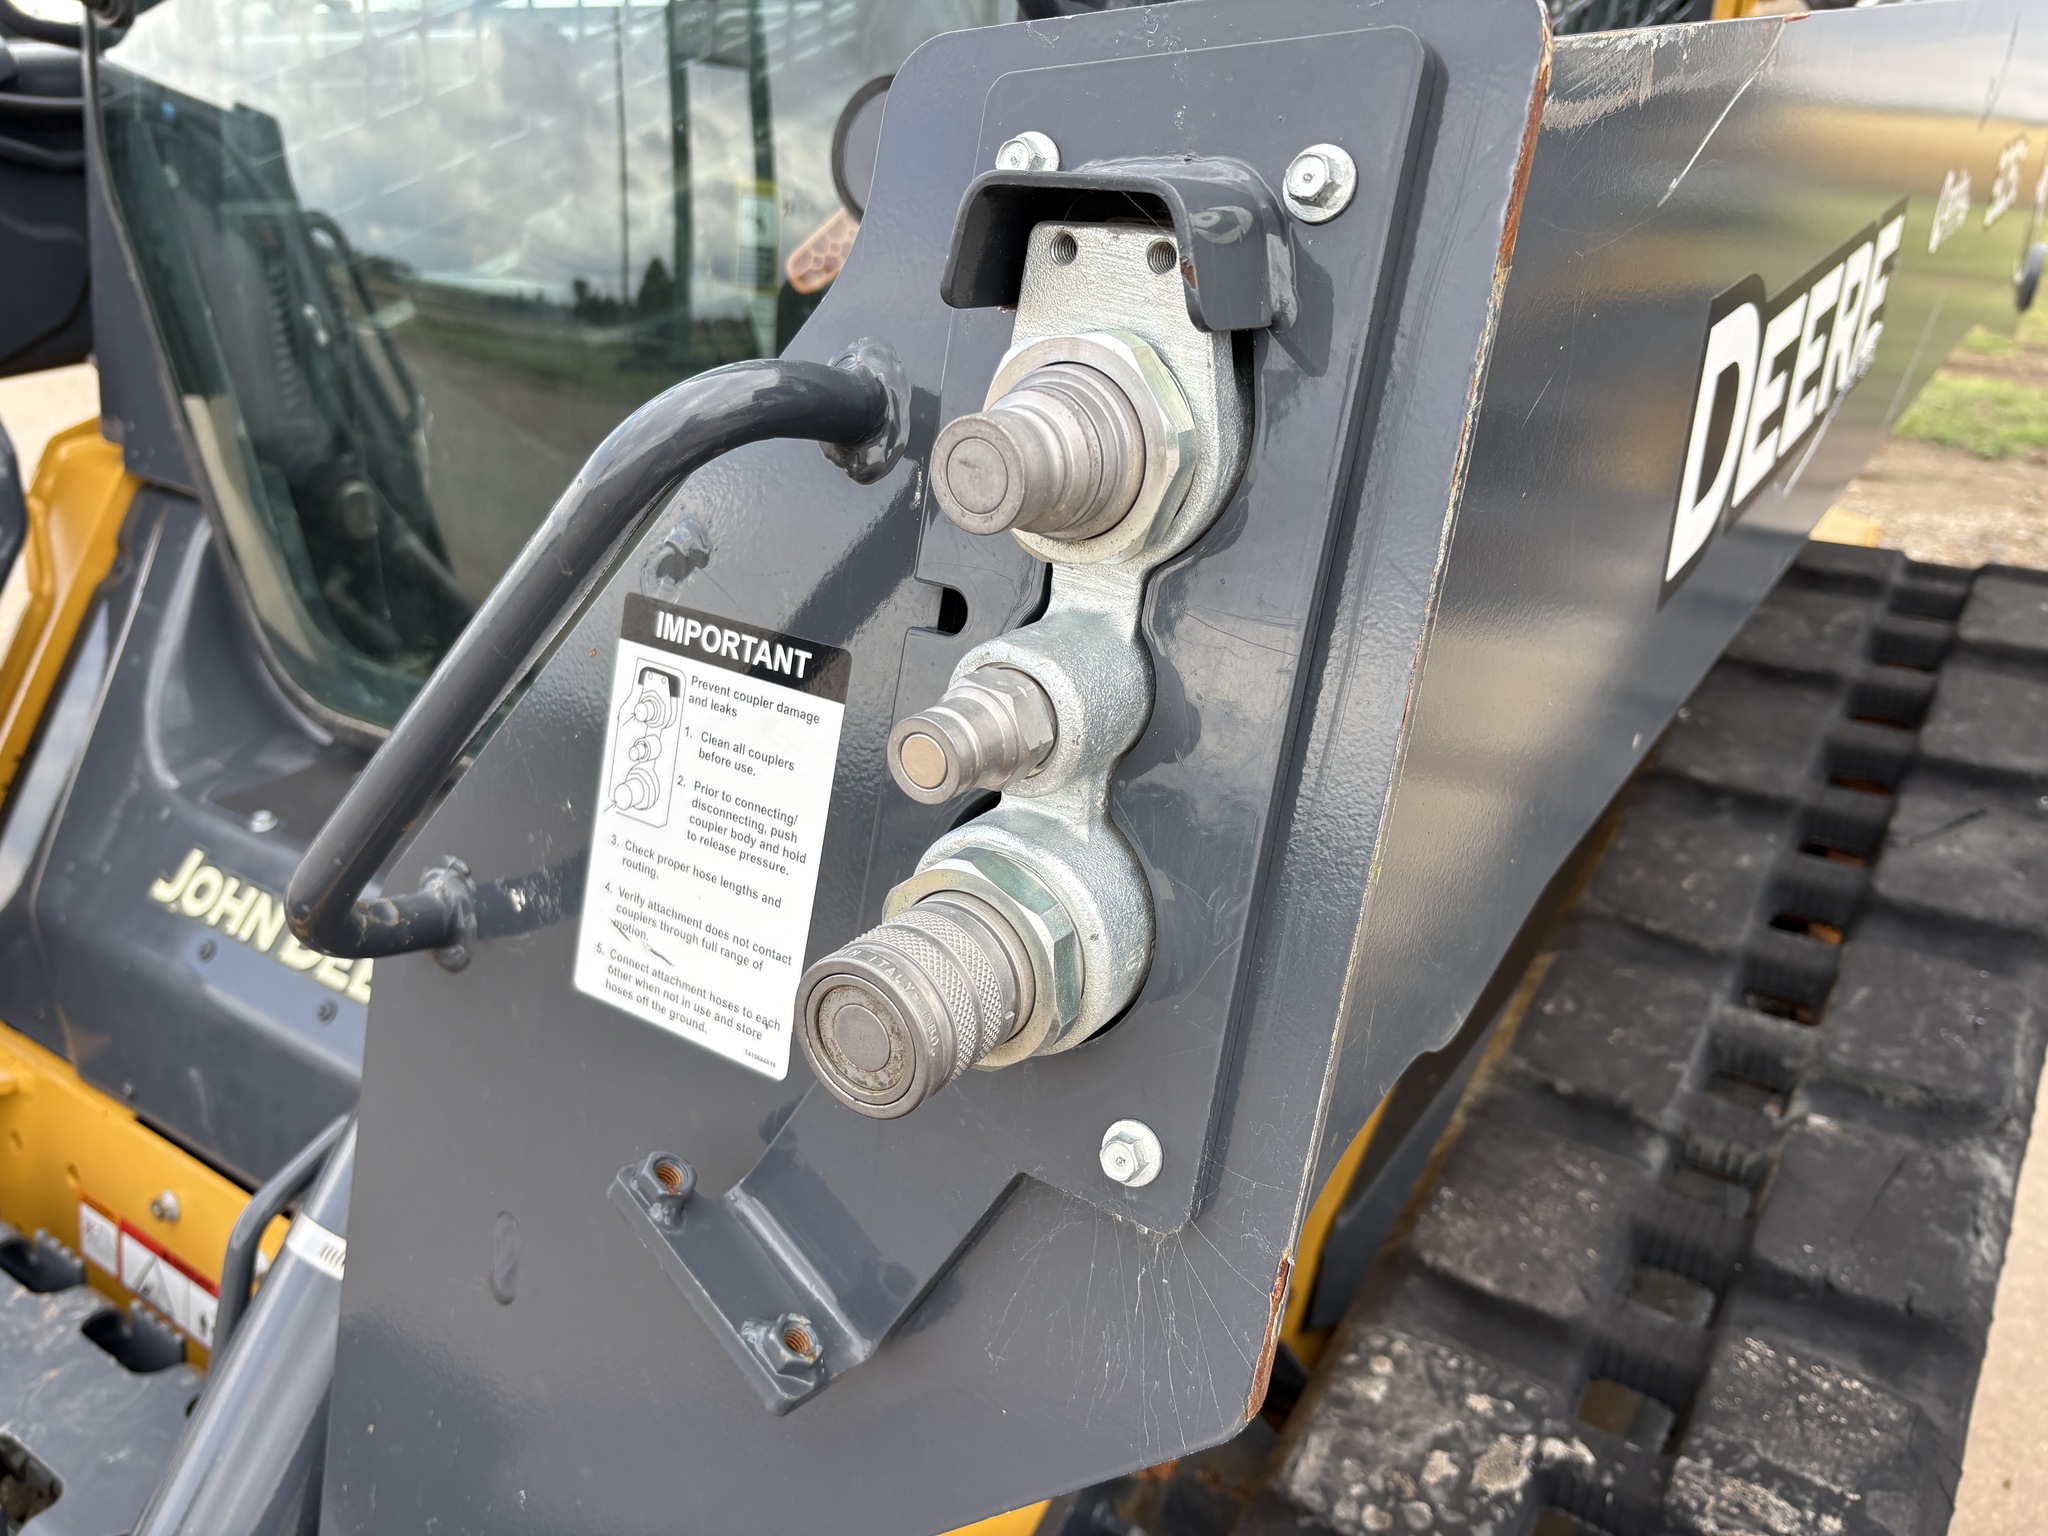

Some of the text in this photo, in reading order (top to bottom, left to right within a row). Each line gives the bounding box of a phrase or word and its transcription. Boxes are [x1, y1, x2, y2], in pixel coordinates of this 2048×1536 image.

[1664, 212, 1907, 583] DEERE
[655, 611, 812, 679] IMPORTANT
[689, 694, 737, 718] and leaks
[690, 675, 820, 725] Prevent coupler damage
[684, 726, 795, 772] 1. Clean all couplers
[698, 749, 756, 777] before use.
[677, 775, 799, 826] 2. Prior to connecting/
[691, 798, 798, 844] disconnecting, push
[687, 830, 789, 876] to release pressure.
[689, 815, 807, 864] coupler body and hold
[611, 834, 782, 908] 3. Check proper hose lengths and
[622, 857, 659, 880] routing.
[150, 848, 286, 953] JOHN
[604, 882, 792, 966] 4. Verify attachment does not contact
[613, 918, 649, 942] motion.
[616, 903, 765, 972] couplers through full range of
[595, 943, 781, 1032] 5. Connect attachment hoses to each
[605, 979, 708, 1035] hoses off the ground.
[608, 964, 763, 1041] other when not in use and store
